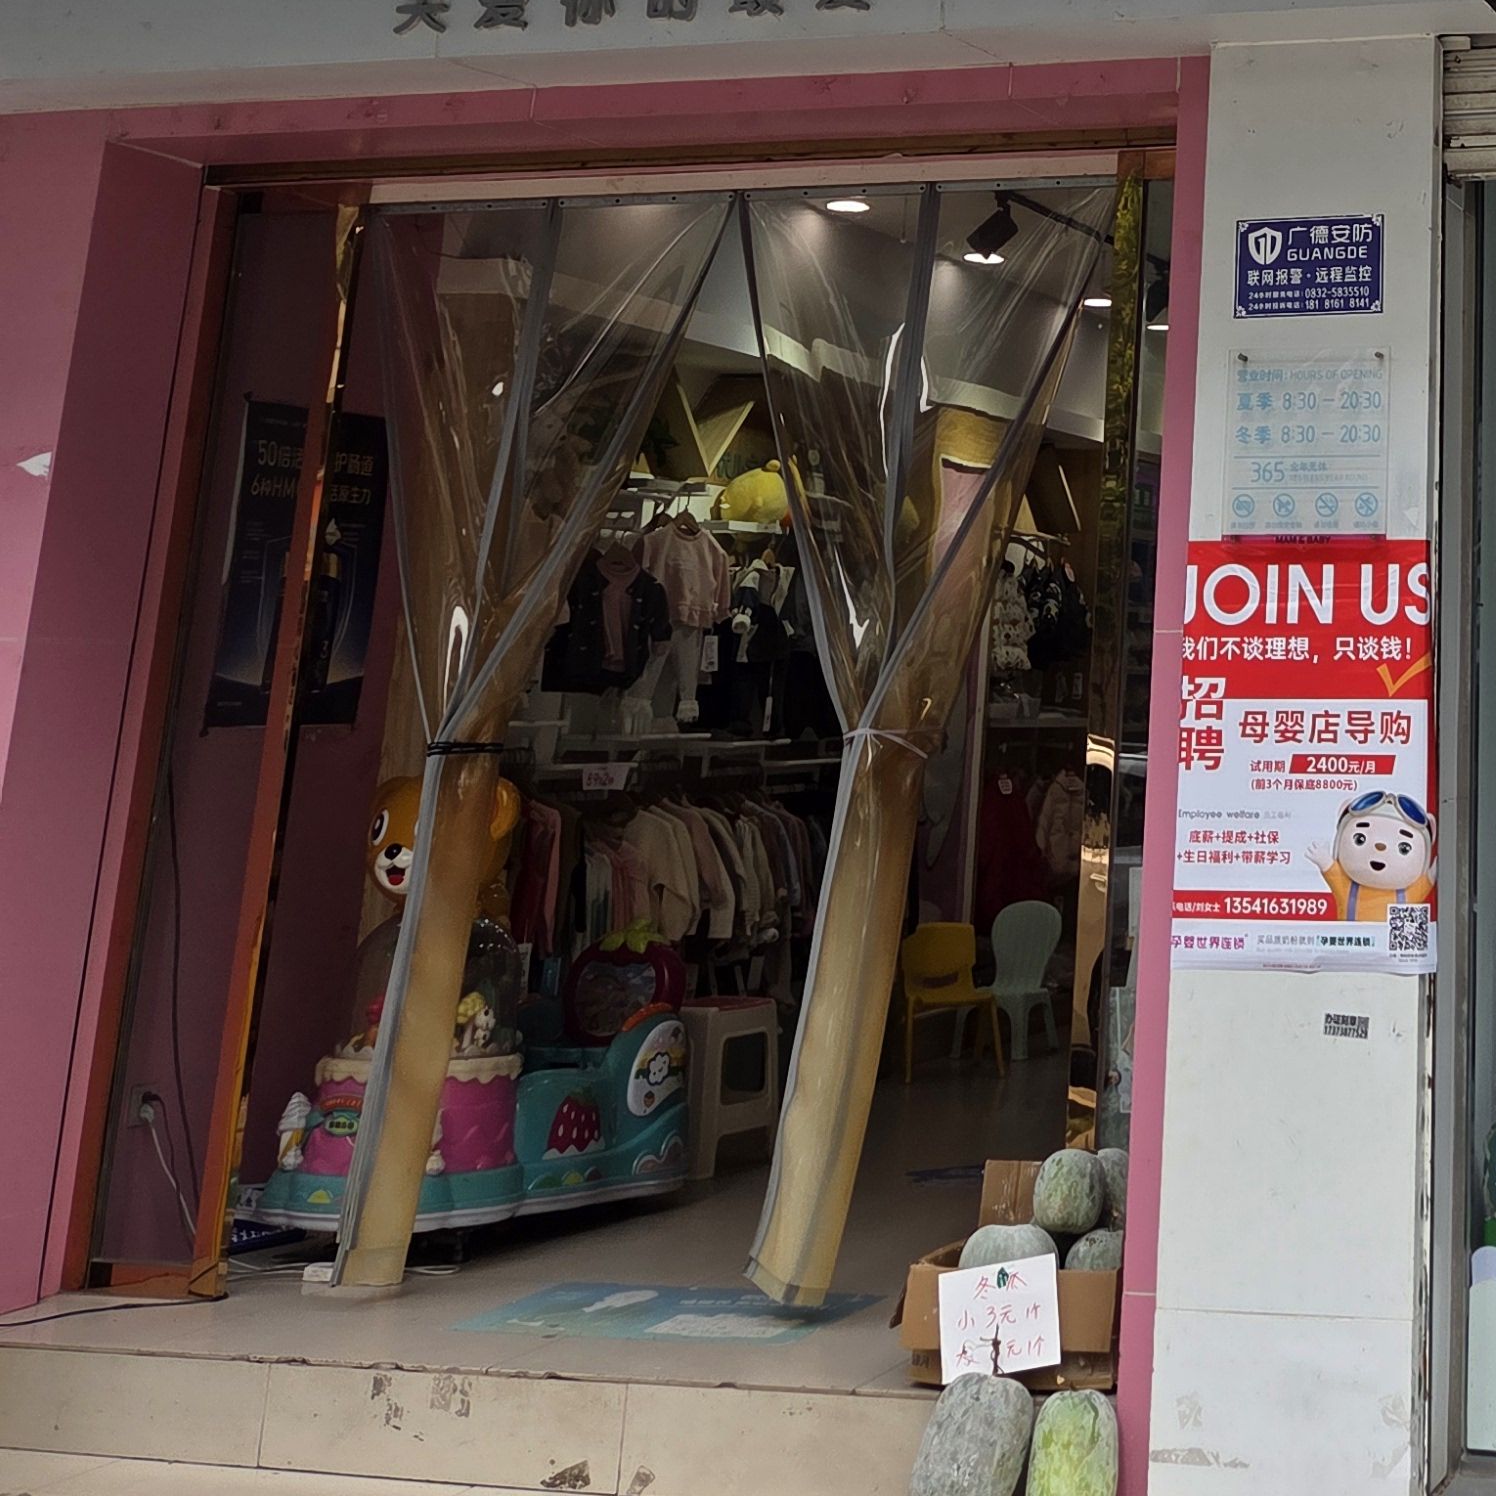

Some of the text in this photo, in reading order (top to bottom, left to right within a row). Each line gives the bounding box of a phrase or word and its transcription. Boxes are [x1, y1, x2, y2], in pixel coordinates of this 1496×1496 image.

[1287, 223, 1373, 245] 广德安防
[1287, 245, 1368, 261] GUANGDE
[1289, 369, 1324, 381] HOURS
[1325, 369, 1339, 379] OF
[1340, 368, 1383, 380] OPENING
[1282, 391, 1317, 410] 8:30
[1340, 390, 1382, 409] 20:30
[1235, 425, 1272, 444] 冬季
[1281, 425, 1316, 443] 8:30
[1339, 424, 1382, 443] 20:30
[1250, 461, 1286, 483] 365
[1184, 562, 1431, 626] JOIN US
[1239, 710, 1412, 745] 母婴店导购
[1250, 756, 1376, 774] 试用期 2400元/月
[1226, 809, 1260, 819] welfare
[1189, 830, 1280, 844] 底薪+提成+社保
[1177, 850, 1291, 865] +生日福利+带薪学习
[1224, 897, 1328, 915] 13541631989
